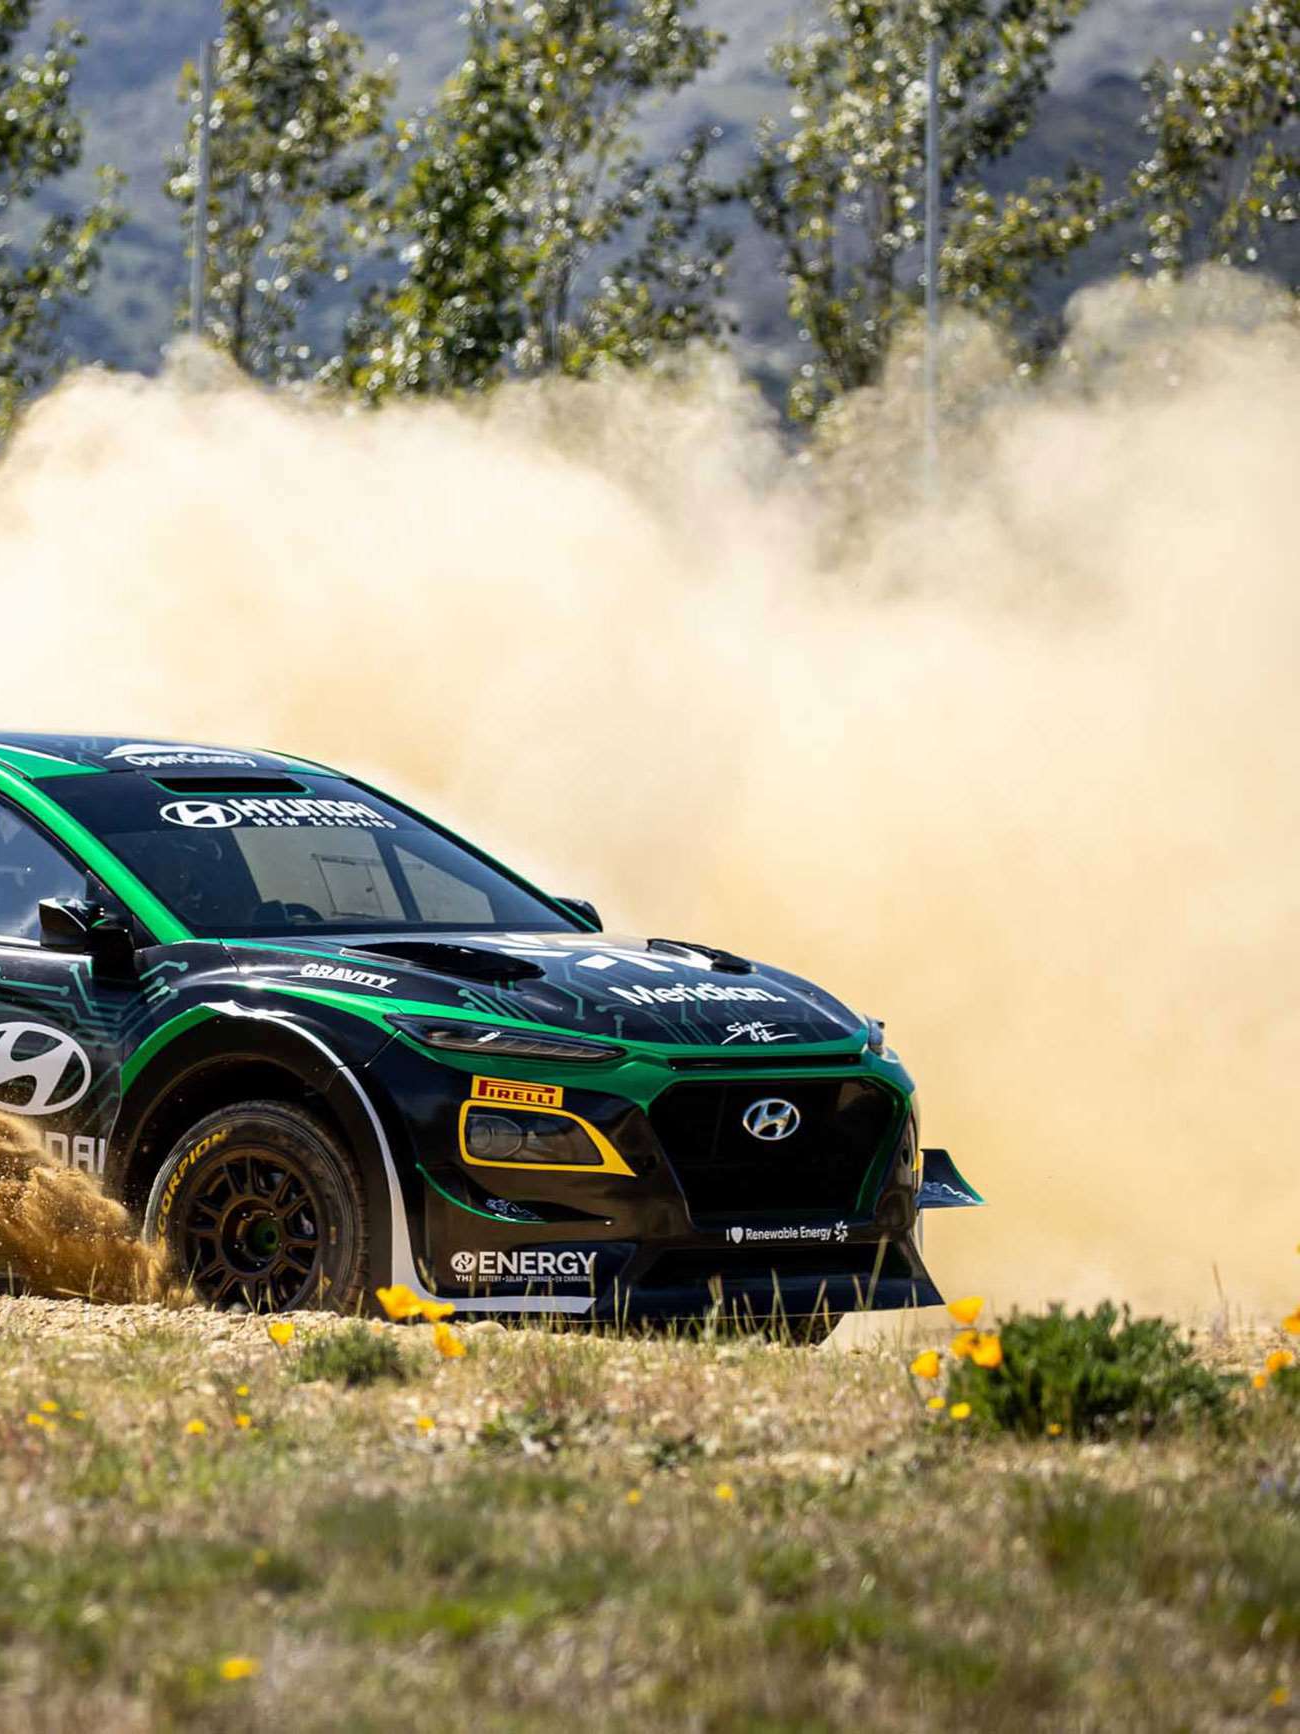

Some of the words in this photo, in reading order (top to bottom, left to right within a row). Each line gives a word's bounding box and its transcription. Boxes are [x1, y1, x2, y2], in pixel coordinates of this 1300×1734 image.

[226, 799, 384, 820] HYUNDAI
[252, 817, 300, 827] NEW
[308, 817, 397, 829] ZEALAND
[300, 963, 398, 988] GRAVITY
[478, 1079, 556, 1104] PIRELLI
[745, 1227, 799, 1240] Renewable
[800, 1226, 832, 1240] Energy
[478, 1251, 598, 1275] ENERGY
